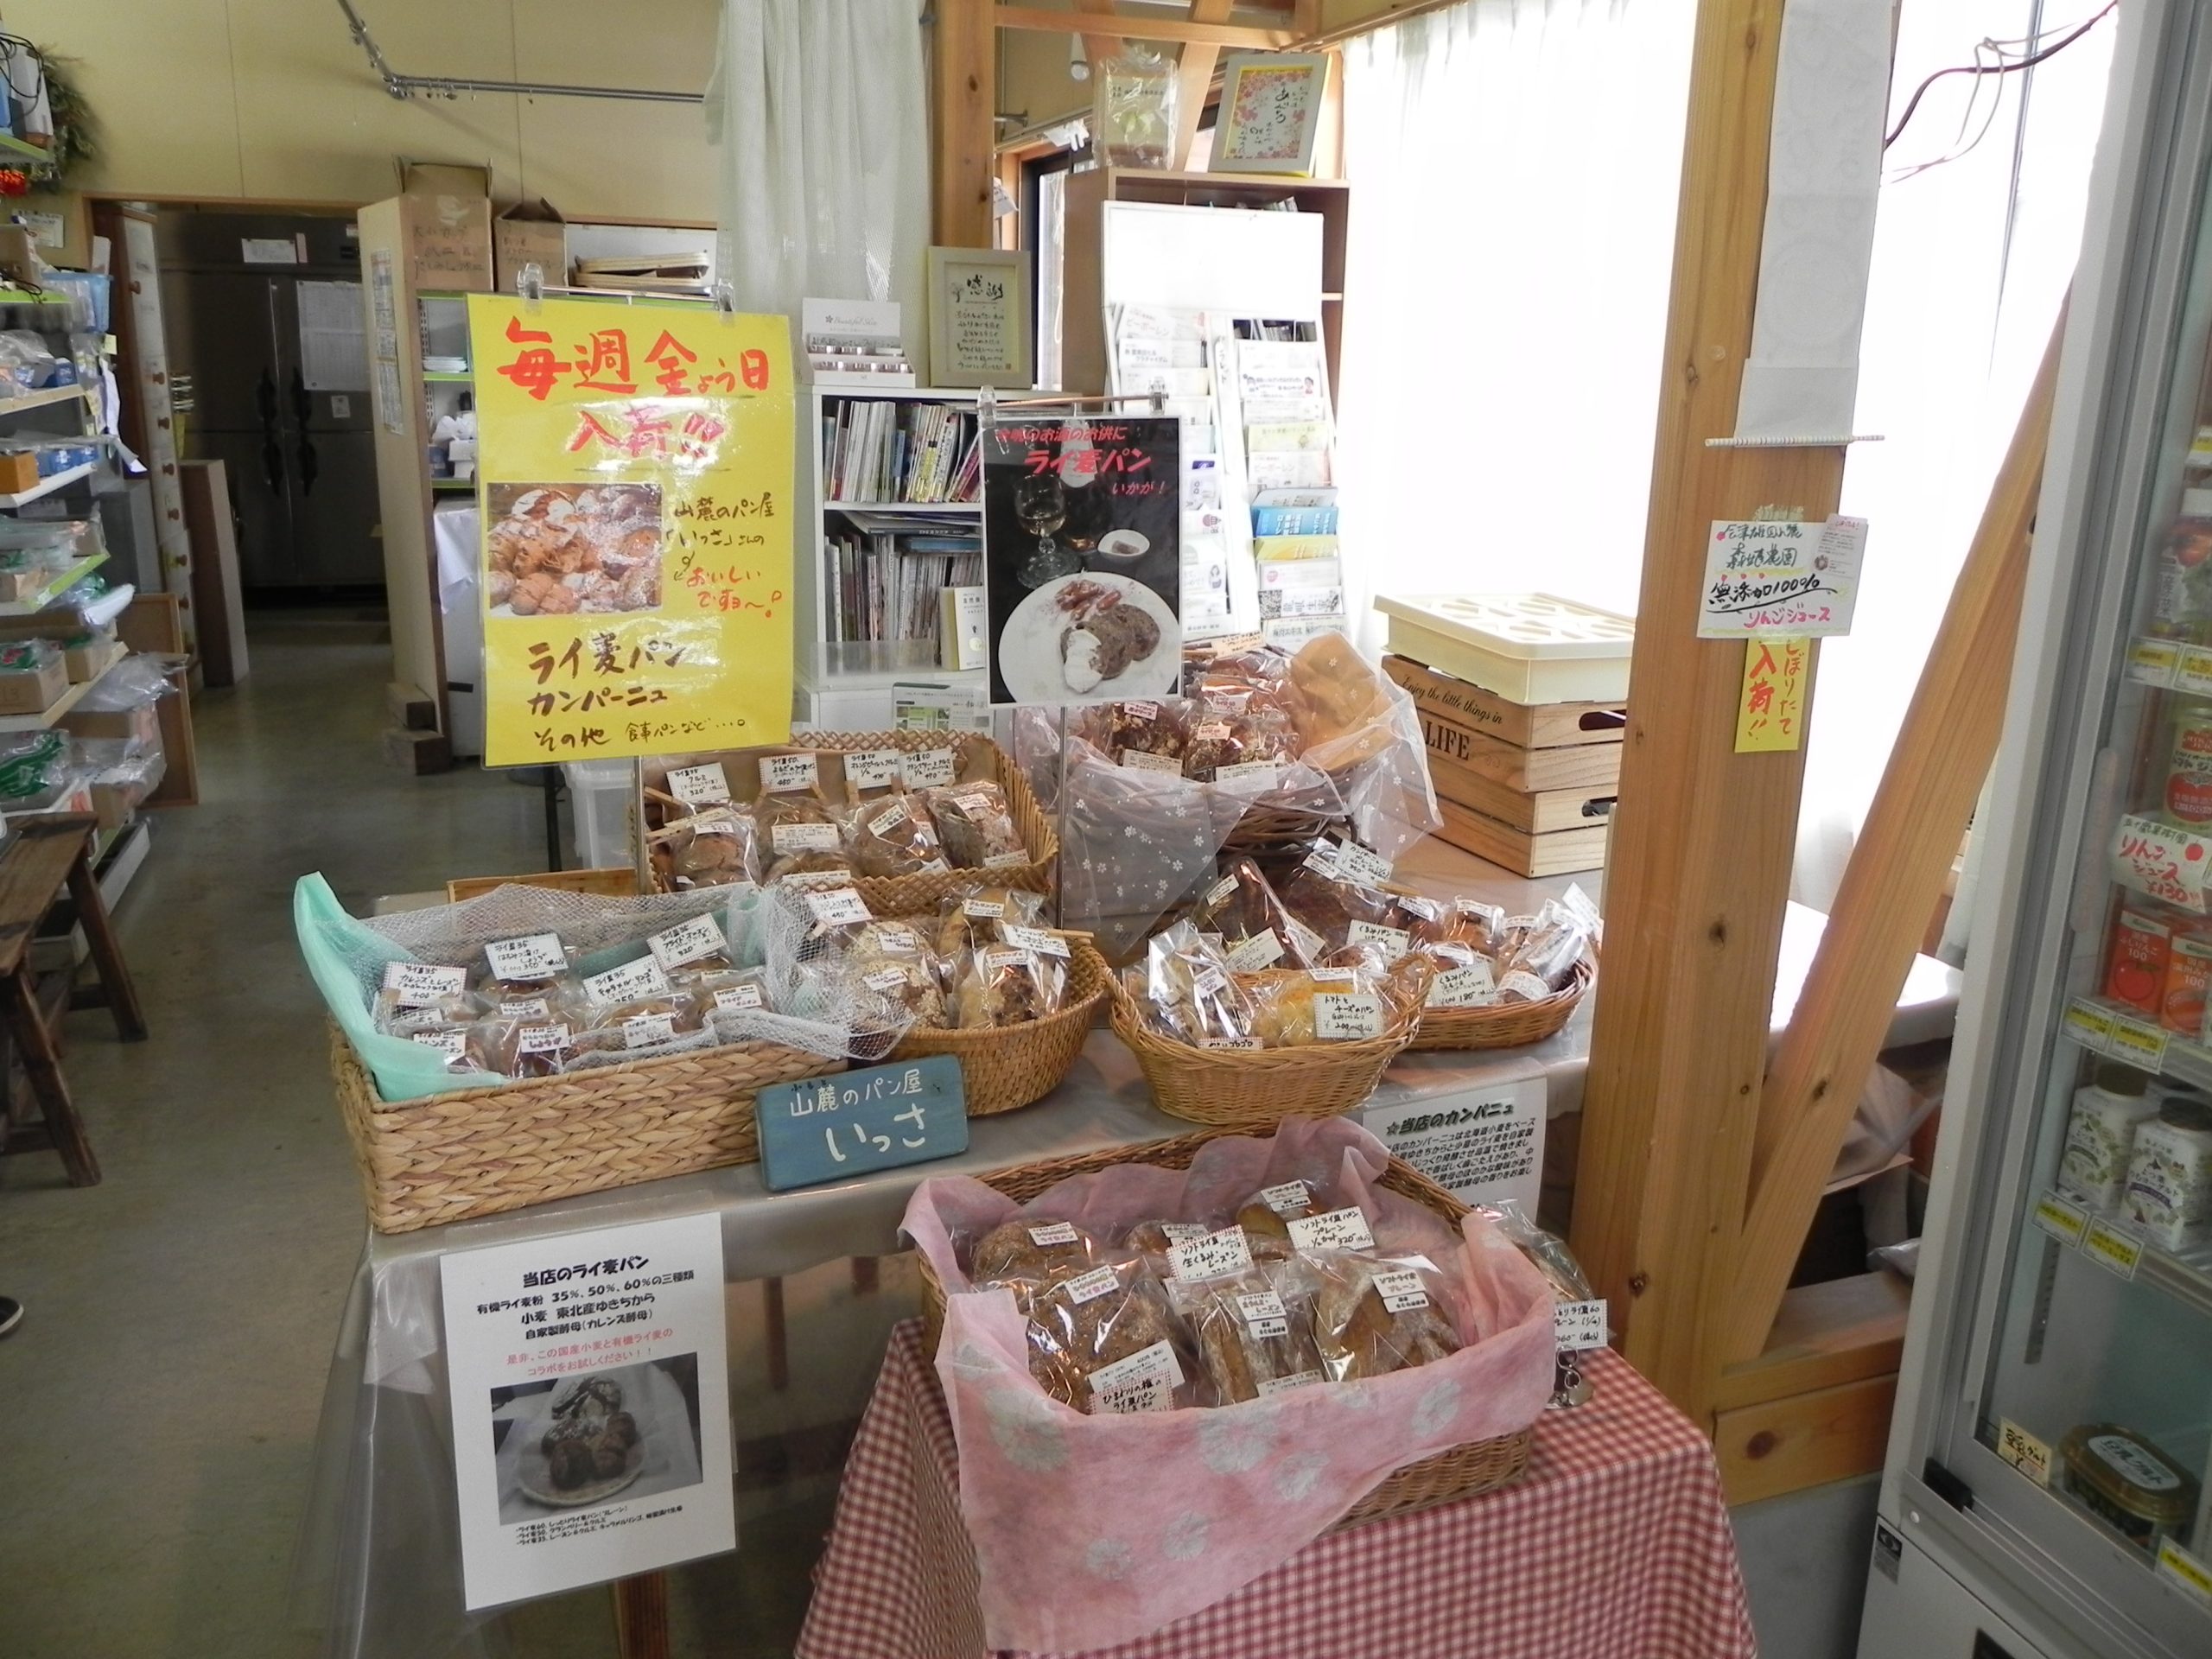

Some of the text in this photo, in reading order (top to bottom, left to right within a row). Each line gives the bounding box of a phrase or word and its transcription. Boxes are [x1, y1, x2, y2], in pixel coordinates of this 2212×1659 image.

[497, 315, 769, 401] 毎週金よう日
[1025, 448, 1152, 474] ライ麦パン
[528, 632, 686, 684] ライ麦パン
[527, 686, 668, 715] カンパーニュ
[1402, 677, 1503, 725] Enjoy the little things in
[534, 727, 612, 752] その他
[1426, 720, 1470, 761] LIFE
[2128, 948, 2148, 962] 100
[2184, 975, 2206, 988] 100
[790, 1068, 923, 1117] 山麓のパン屋
[825, 1103, 925, 1161] いっさ
[523, 1255, 649, 1289] 当店のライ麦パン
[477, 1294, 543, 1315] 有機ライ麦粉
[521, 1293, 656, 1325] 小麦 東北産ゆきちから
